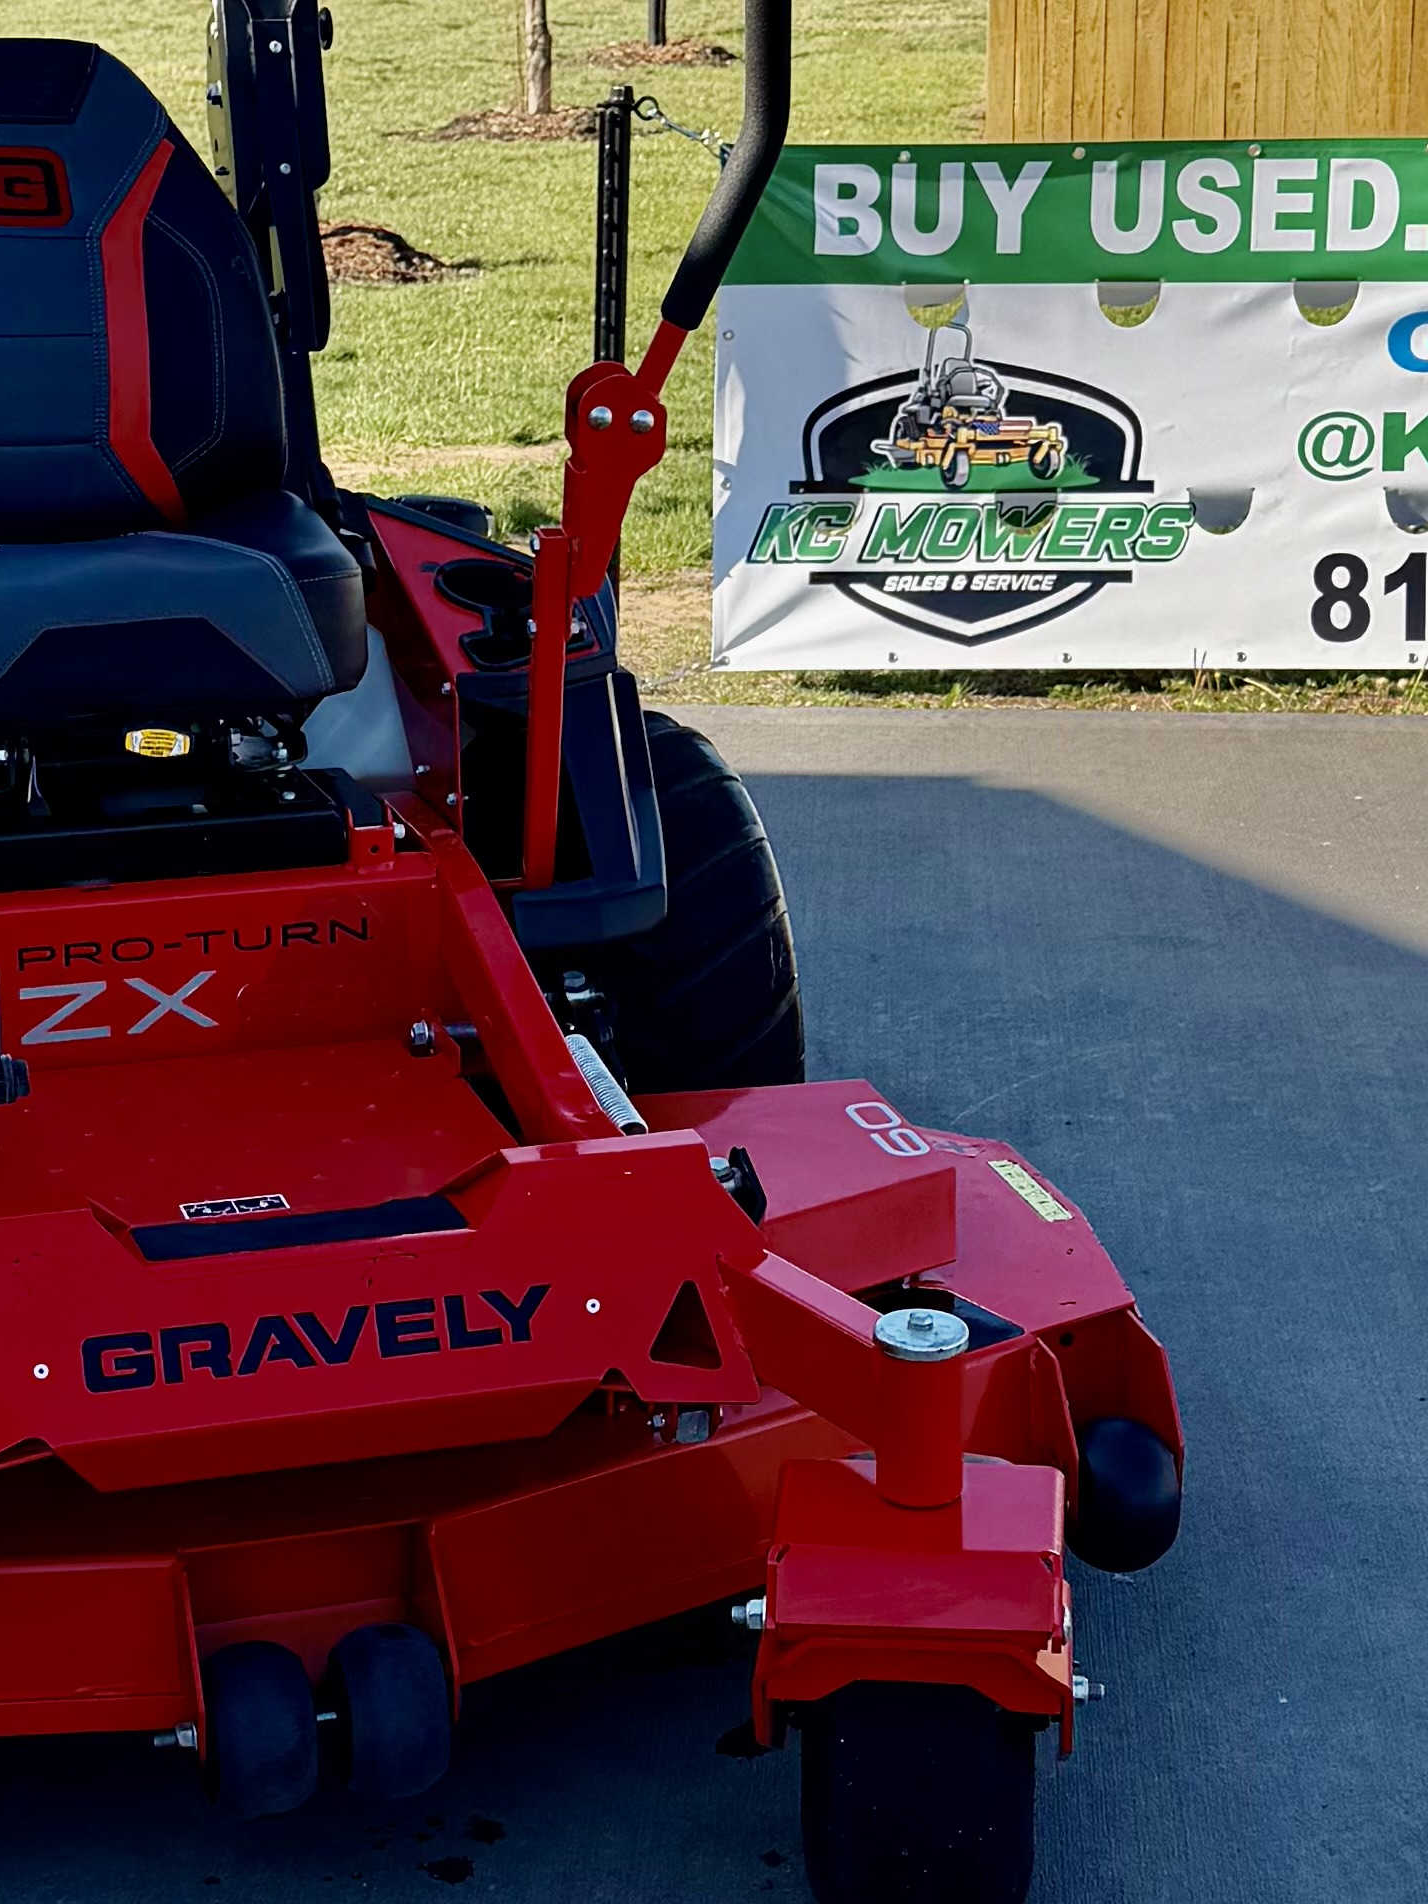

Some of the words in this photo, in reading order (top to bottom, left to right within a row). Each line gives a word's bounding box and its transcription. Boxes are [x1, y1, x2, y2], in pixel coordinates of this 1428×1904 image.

[813, 160, 1053, 257] BUY
[746, 502, 860, 563] KC
[858, 502, 1197, 563] MOWERS
[883, 575, 949, 592] SALES
[951, 574, 968, 591] &
[970, 573, 1057, 591] SERVICE
[17, 916, 374, 972] PRO-TURN
[18, 969, 220, 1045] ZX
[845, 1101, 930, 1156] 60
[80, 1283, 552, 1394] GRAVELY
